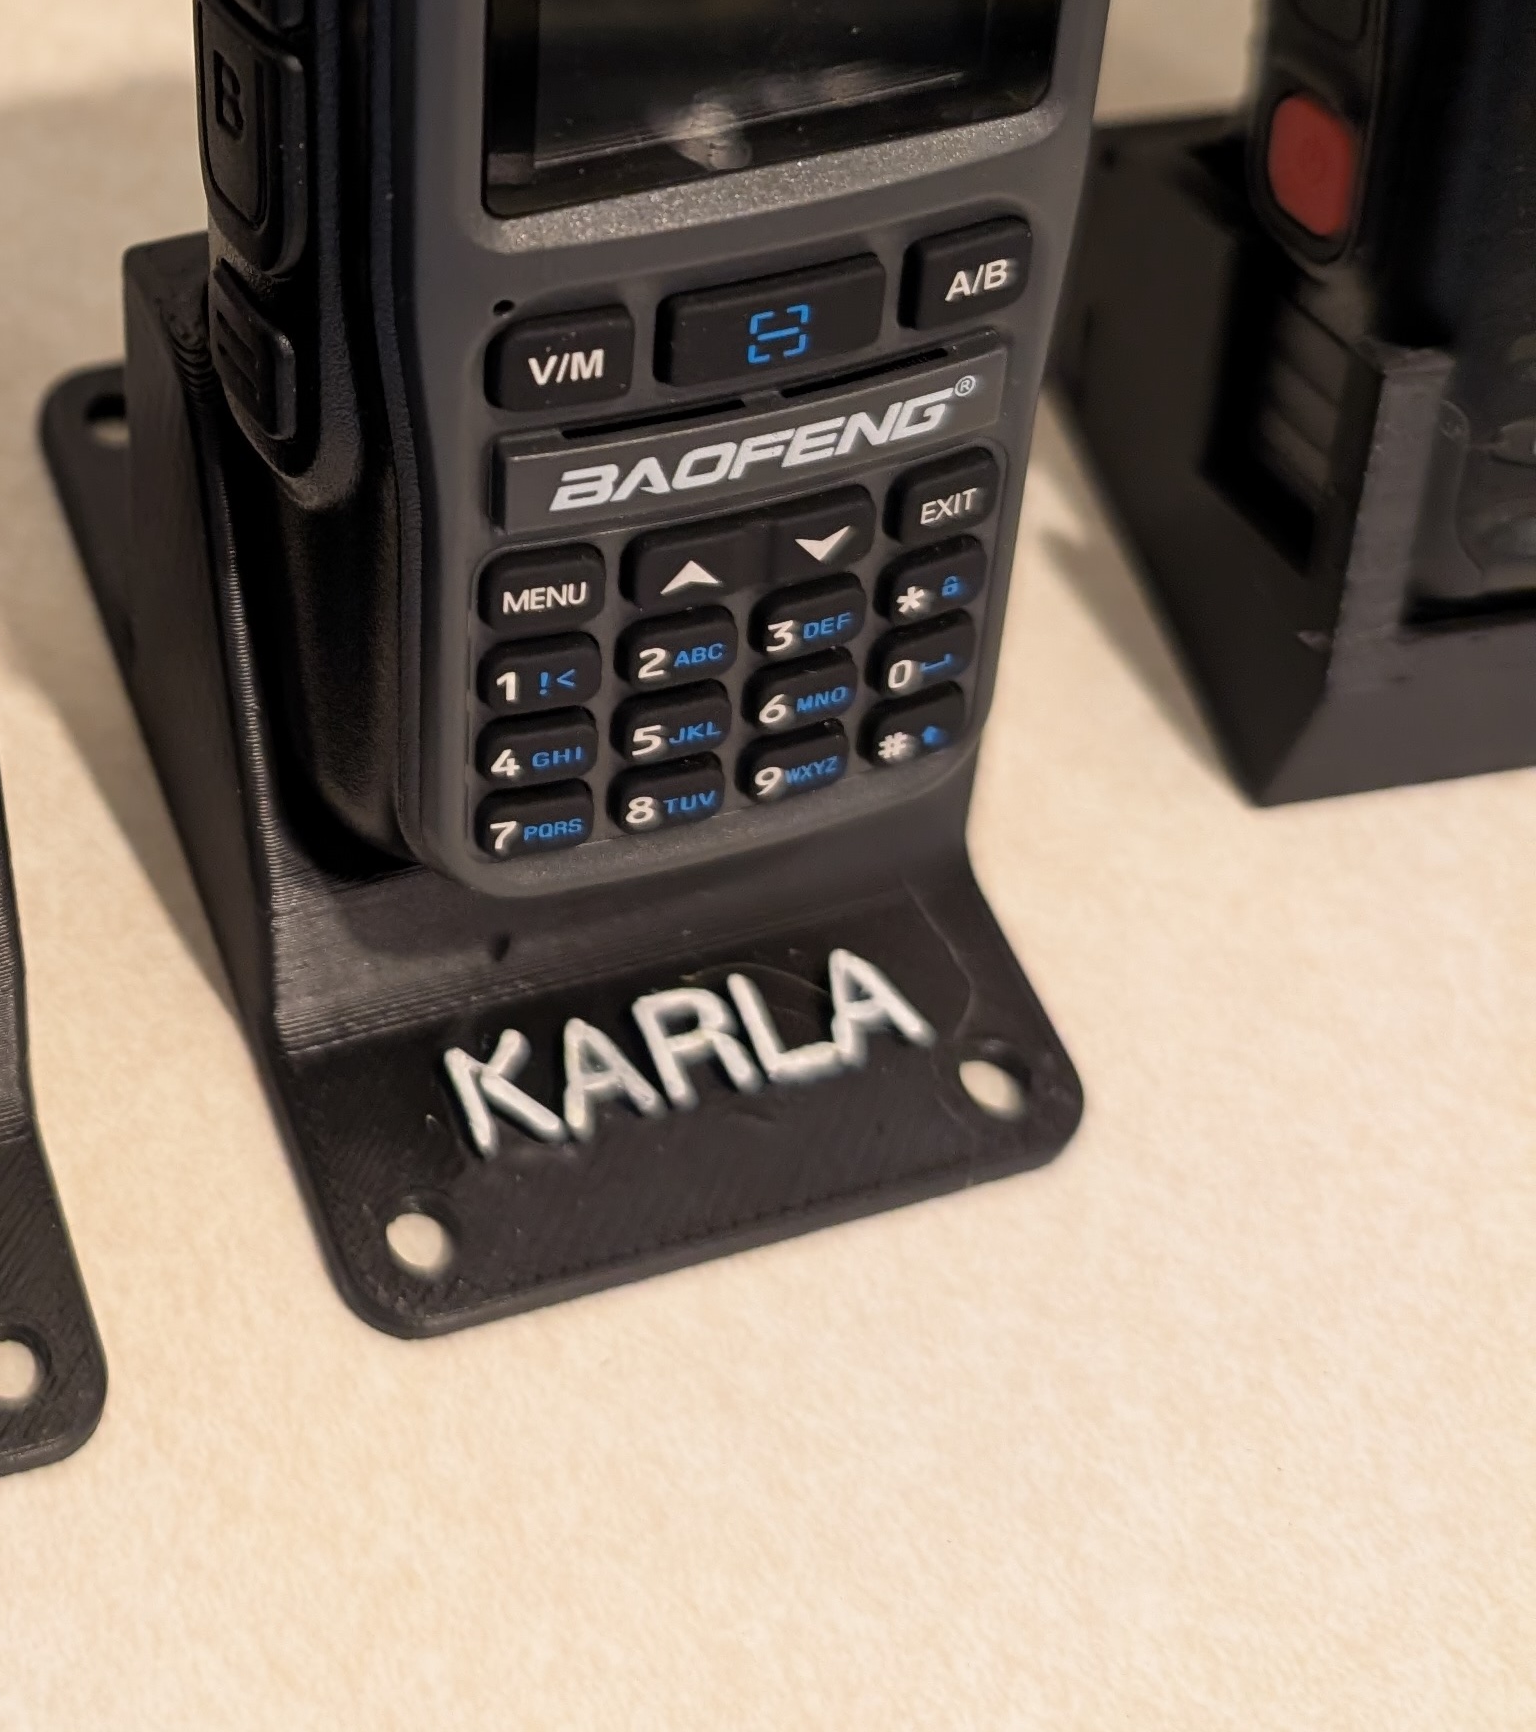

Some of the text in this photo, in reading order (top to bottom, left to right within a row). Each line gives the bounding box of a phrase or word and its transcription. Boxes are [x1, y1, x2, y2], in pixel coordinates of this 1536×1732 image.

[215, 50, 245, 133] B
[945, 259, 1008, 302] A/B
[528, 349, 604, 386] V/M
[920, 487, 978, 525] EXIT
[502, 583, 587, 614] MENU
[767, 612, 851, 652] 3 DEF
[637, 642, 725, 678] 2 ABC
[887, 659, 912, 689] 0
[496, 671, 519, 701] 1
[758, 685, 848, 725] 6 MNO
[631, 719, 722, 754] 5 JKL
[490, 745, 583, 777] 4 GHI
[754, 755, 838, 796] 9 WXYZ
[625, 788, 716, 823] 8 TUV
[490, 816, 583, 850] 7 PQRS
[444, 948, 936, 1159] KARLA
